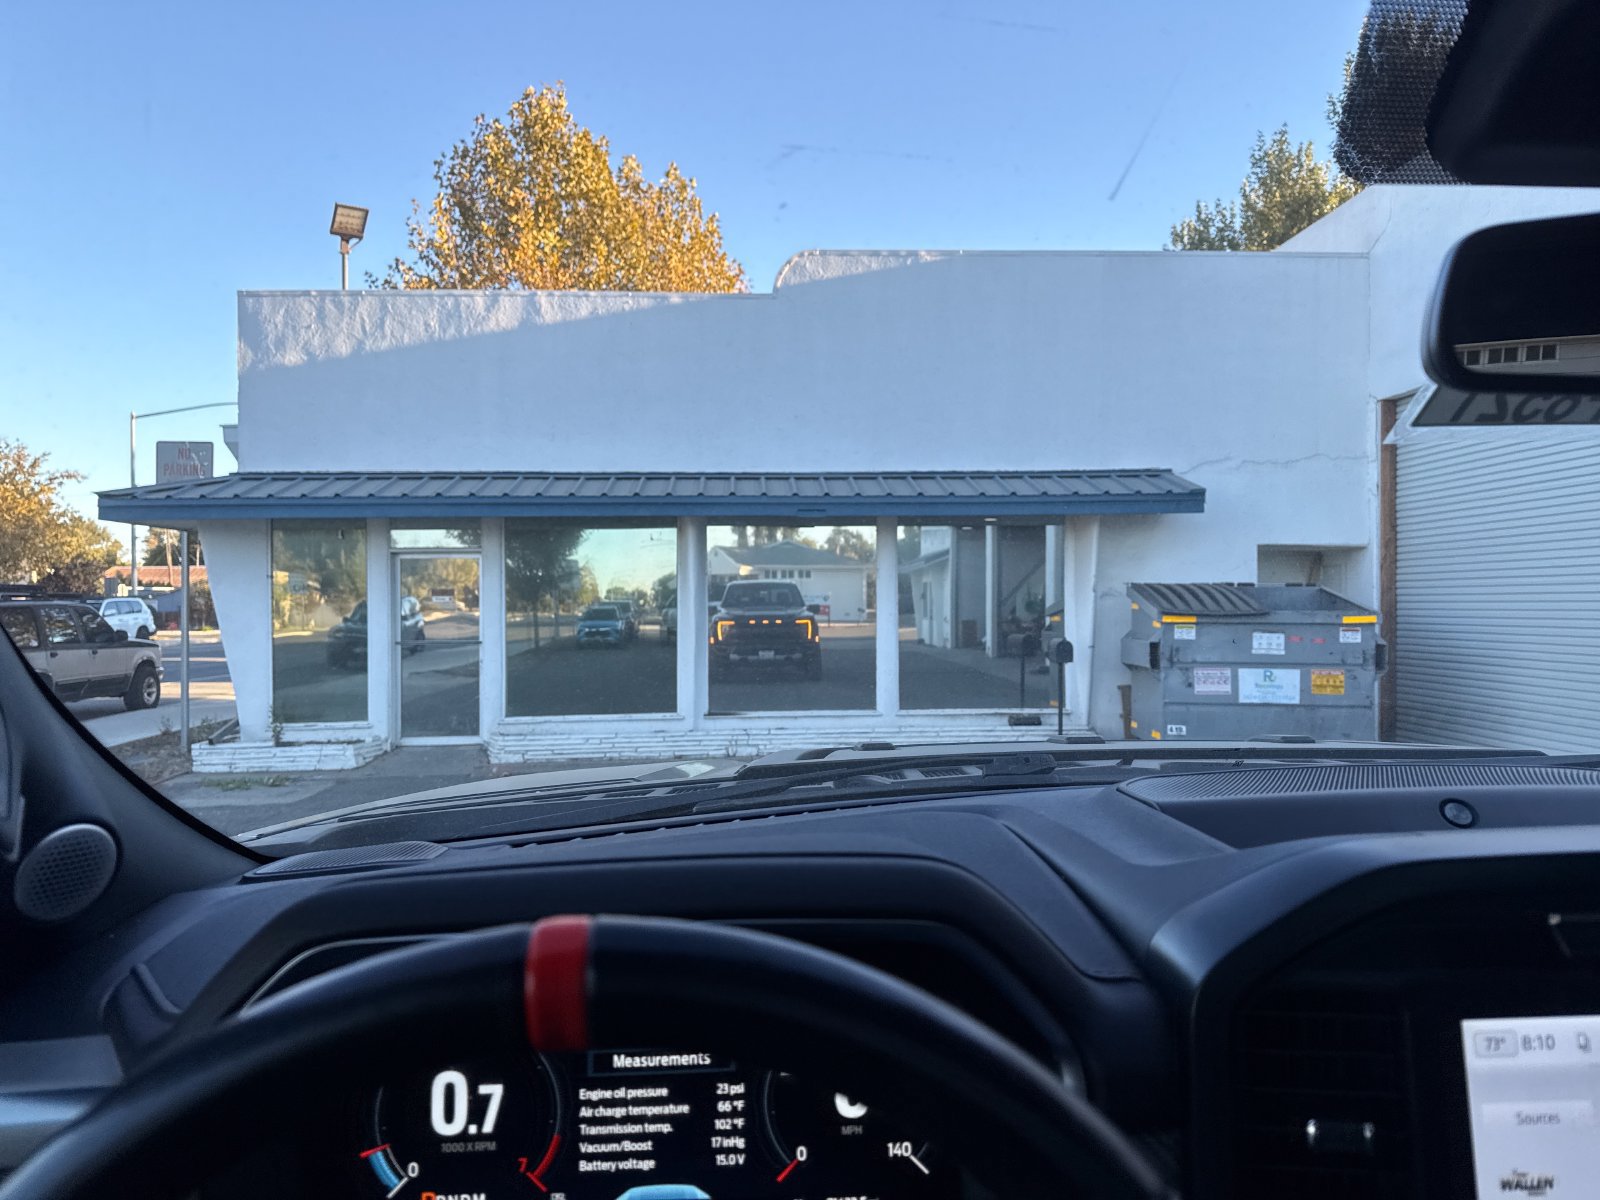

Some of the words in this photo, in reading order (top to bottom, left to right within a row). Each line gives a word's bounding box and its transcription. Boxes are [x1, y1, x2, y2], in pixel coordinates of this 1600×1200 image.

[178, 448, 192, 460] NO
[163, 463, 206, 477] PARKING
[1521, 1034, 1556, 1051] 8:10
[612, 1053, 711, 1069] Measurements
[579, 1088, 613, 1102] Engine
[614, 1087, 626, 1099] oil
[627, 1087, 668, 1100] pressure
[716, 1083, 729, 1095] 23
[730, 1083, 745, 1096] psi
[430, 1070, 504, 1136] 0.7
[717, 1101, 732, 1112] 66
[579, 1106, 593, 1117] Air
[594, 1105, 627, 1118] charge
[628, 1104, 690, 1118] temperature
[714, 1118, 732, 1130] 102
[1516, 1111, 1561, 1126] Sources
[579, 1123, 643, 1135] Transmission
[644, 1123, 673, 1135] temp.
[841, 1125, 863, 1135] MPH
[441, 1142, 466, 1153] 1000
[475, 1141, 497, 1152] RPM
[579, 1140, 653, 1153] Vacuum/Boost
[710, 1137, 721, 1148] 17
[722, 1137, 745, 1150] inHg
[887, 1141, 912, 1158] 140
[715, 1154, 736, 1166] 15.0
[736, 1154, 746, 1165] V
[796, 1145, 807, 1161] 0
[407, 1162, 419, 1178] 0
[518, 1157, 528, 1173] 7
[579, 1160, 617, 1172] Battery
[618, 1158, 656, 1171] voltage
[1500, 1176, 1555, 1192] WALLEN
